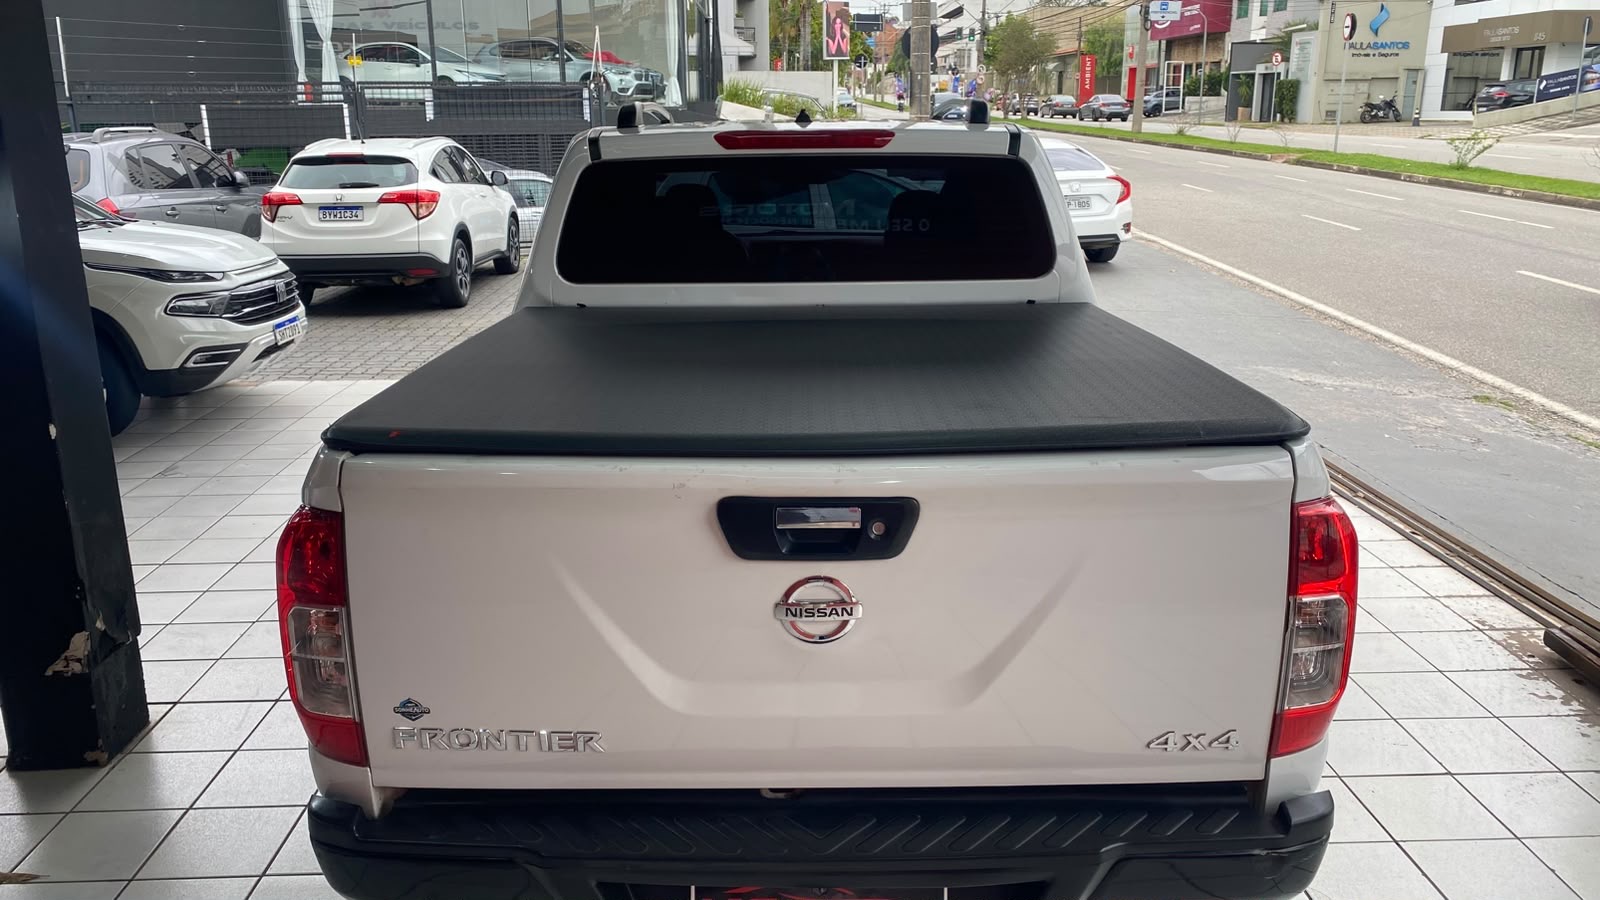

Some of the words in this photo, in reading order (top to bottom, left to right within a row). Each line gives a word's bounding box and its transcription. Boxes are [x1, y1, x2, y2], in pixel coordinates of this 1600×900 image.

[1084, 56, 1092, 89] AMBIENT
[322, 210, 359, 219] BYW1C34
[785, 607, 854, 618] NISSAN
[392, 726, 605, 752] FRONTIER
[1145, 729, 1239, 752] 4x4
